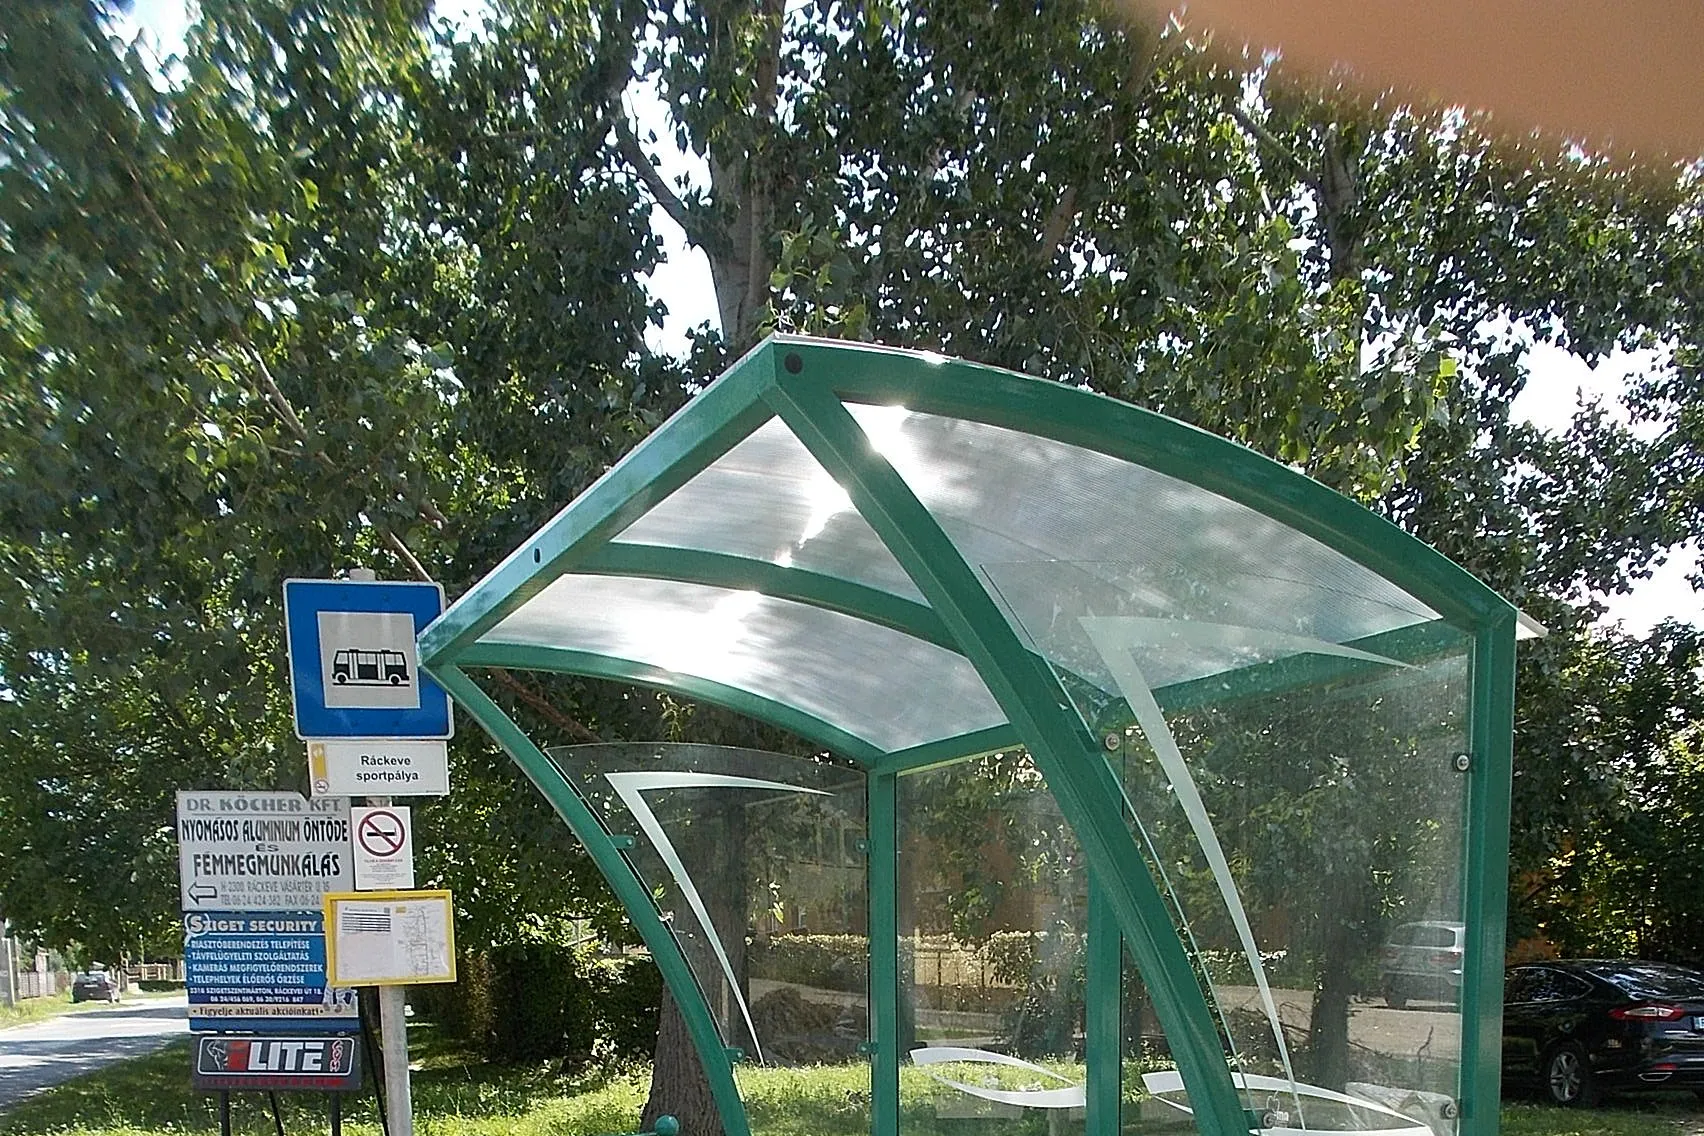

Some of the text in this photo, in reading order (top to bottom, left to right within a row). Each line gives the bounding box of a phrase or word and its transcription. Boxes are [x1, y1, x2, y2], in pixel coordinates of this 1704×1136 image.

[361, 755, 411, 766] Ráckeve
[356, 770, 419, 782] sportpálya
[187, 795, 342, 812] DR. KÖCHER KFT.
[181, 816, 348, 842] NYOMÁSOS ALUMINIUM ÖNTÖDE
[193, 851, 340, 877] FÉMMEGMUNKÁLÁS
[190, 915, 245, 932] SZIGET
[249, 920, 317, 932] SECURITY
[191, 939, 269, 949] RIASZTÓBERENDEZÉS
[192, 950, 310, 961] TÁVFELÜGYELETI SZOLGÁLTATÁS
[192, 962, 323, 972] KAMERÁS MEGFIGYELŐRENDSZEREK
[193, 974, 241, 984] TELEPHELYEK
[200, 1006, 233, 1016] Figyelje
[236, 1006, 269, 1015] aktuális
